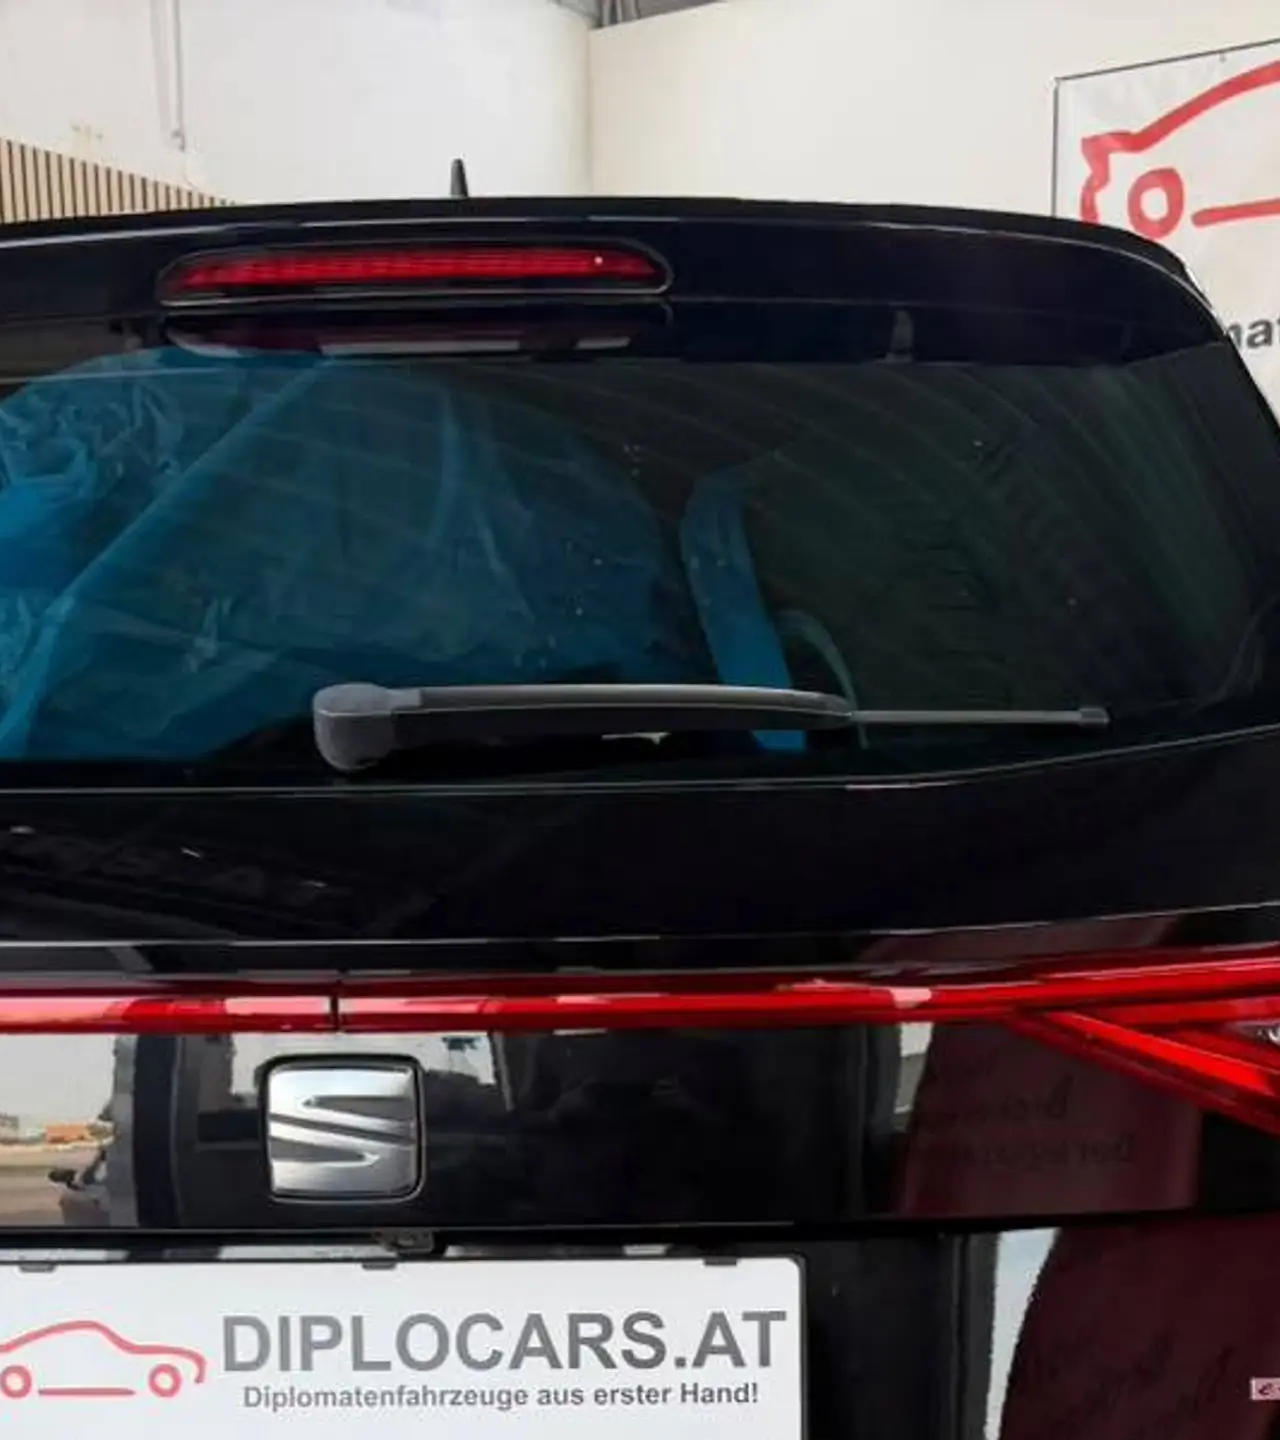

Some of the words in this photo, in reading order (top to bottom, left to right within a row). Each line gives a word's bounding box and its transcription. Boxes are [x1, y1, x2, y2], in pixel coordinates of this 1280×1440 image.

[222, 1311, 787, 1373] DIPLOCARS.AT
[242, 1383, 528, 1411] Diplomatenfahrzeuge
[537, 1387, 584, 1406] aus
[593, 1385, 672, 1405] erster
[680, 1381, 760, 1406] Hand!
